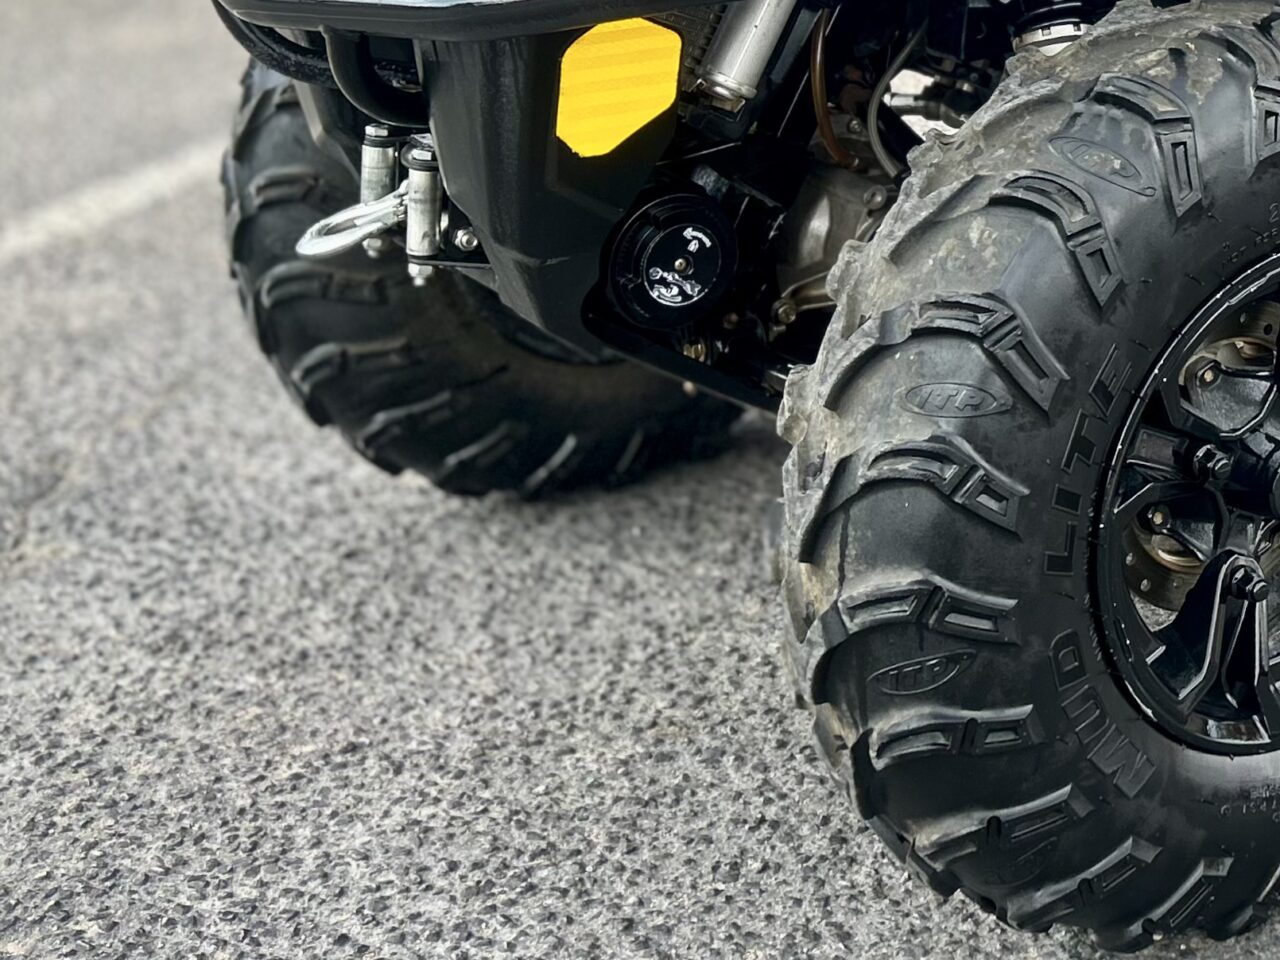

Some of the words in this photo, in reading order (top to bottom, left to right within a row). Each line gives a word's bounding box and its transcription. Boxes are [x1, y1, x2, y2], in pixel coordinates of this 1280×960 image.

[917, 383, 986, 412] ITP
[1044, 343, 1132, 576] LITE
[887, 658, 948, 692] ITP
[1049, 628, 1157, 800] MUD
